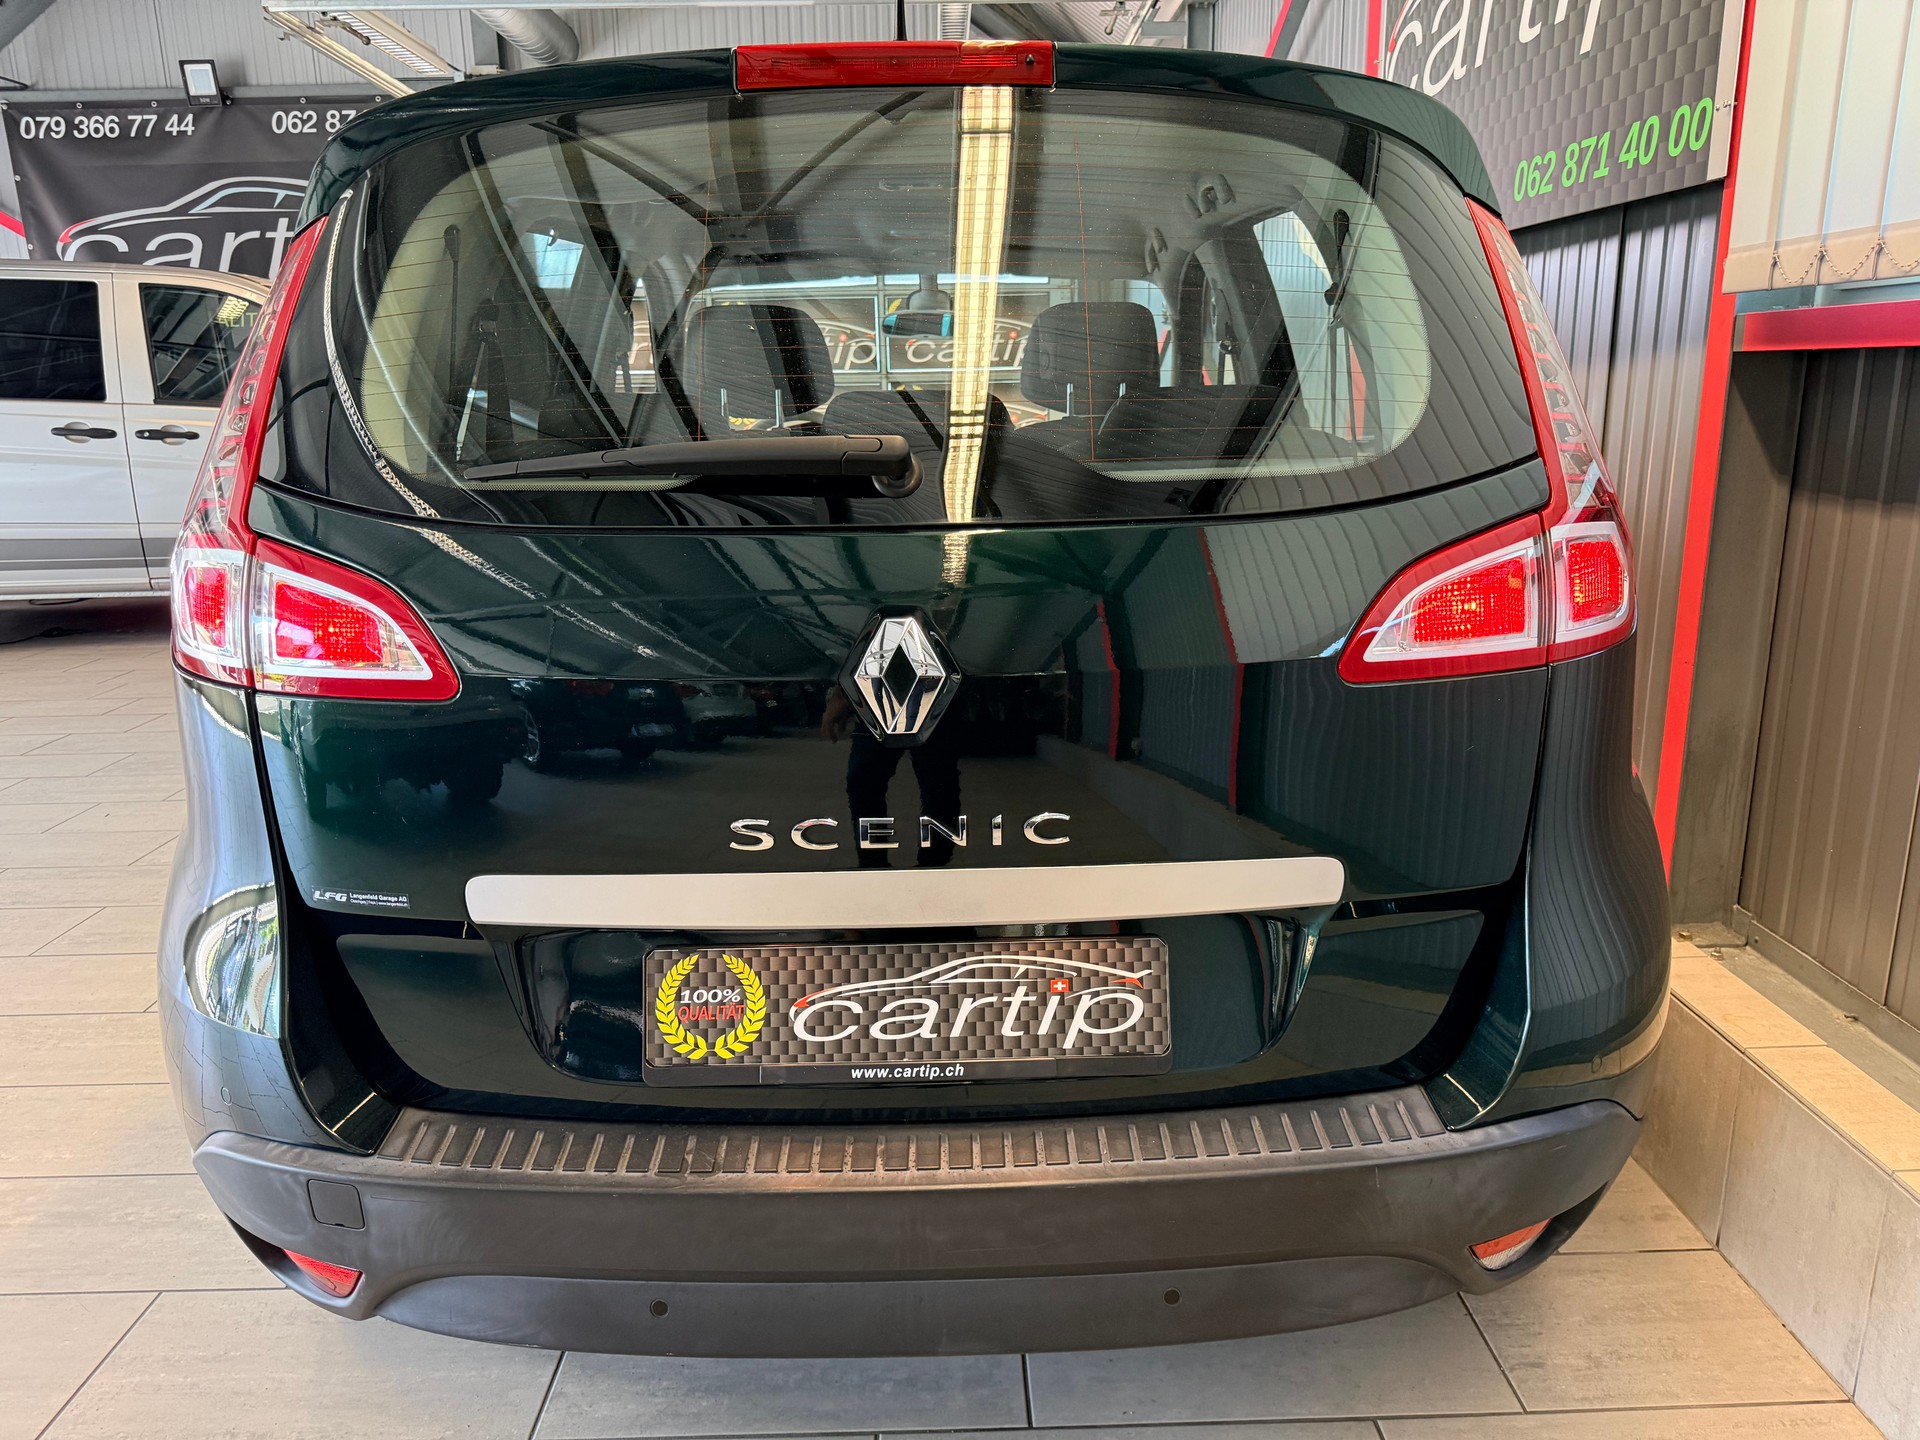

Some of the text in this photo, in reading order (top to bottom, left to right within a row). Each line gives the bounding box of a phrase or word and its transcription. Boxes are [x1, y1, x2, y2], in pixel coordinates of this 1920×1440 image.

[19, 113, 195, 140] 079 366 77 44
[271, 110, 318, 134] 062
[1514, 97, 1714, 202] 062 871 40 00
[729, 811, 1071, 851] SCENIC
[313, 890, 348, 903] LFG
[680, 988, 741, 1003] 100%
[678, 1002, 745, 1024] QUALITÄT
[793, 980, 1145, 1049] cartip
[851, 1063, 965, 1080] www.cartip.ch
